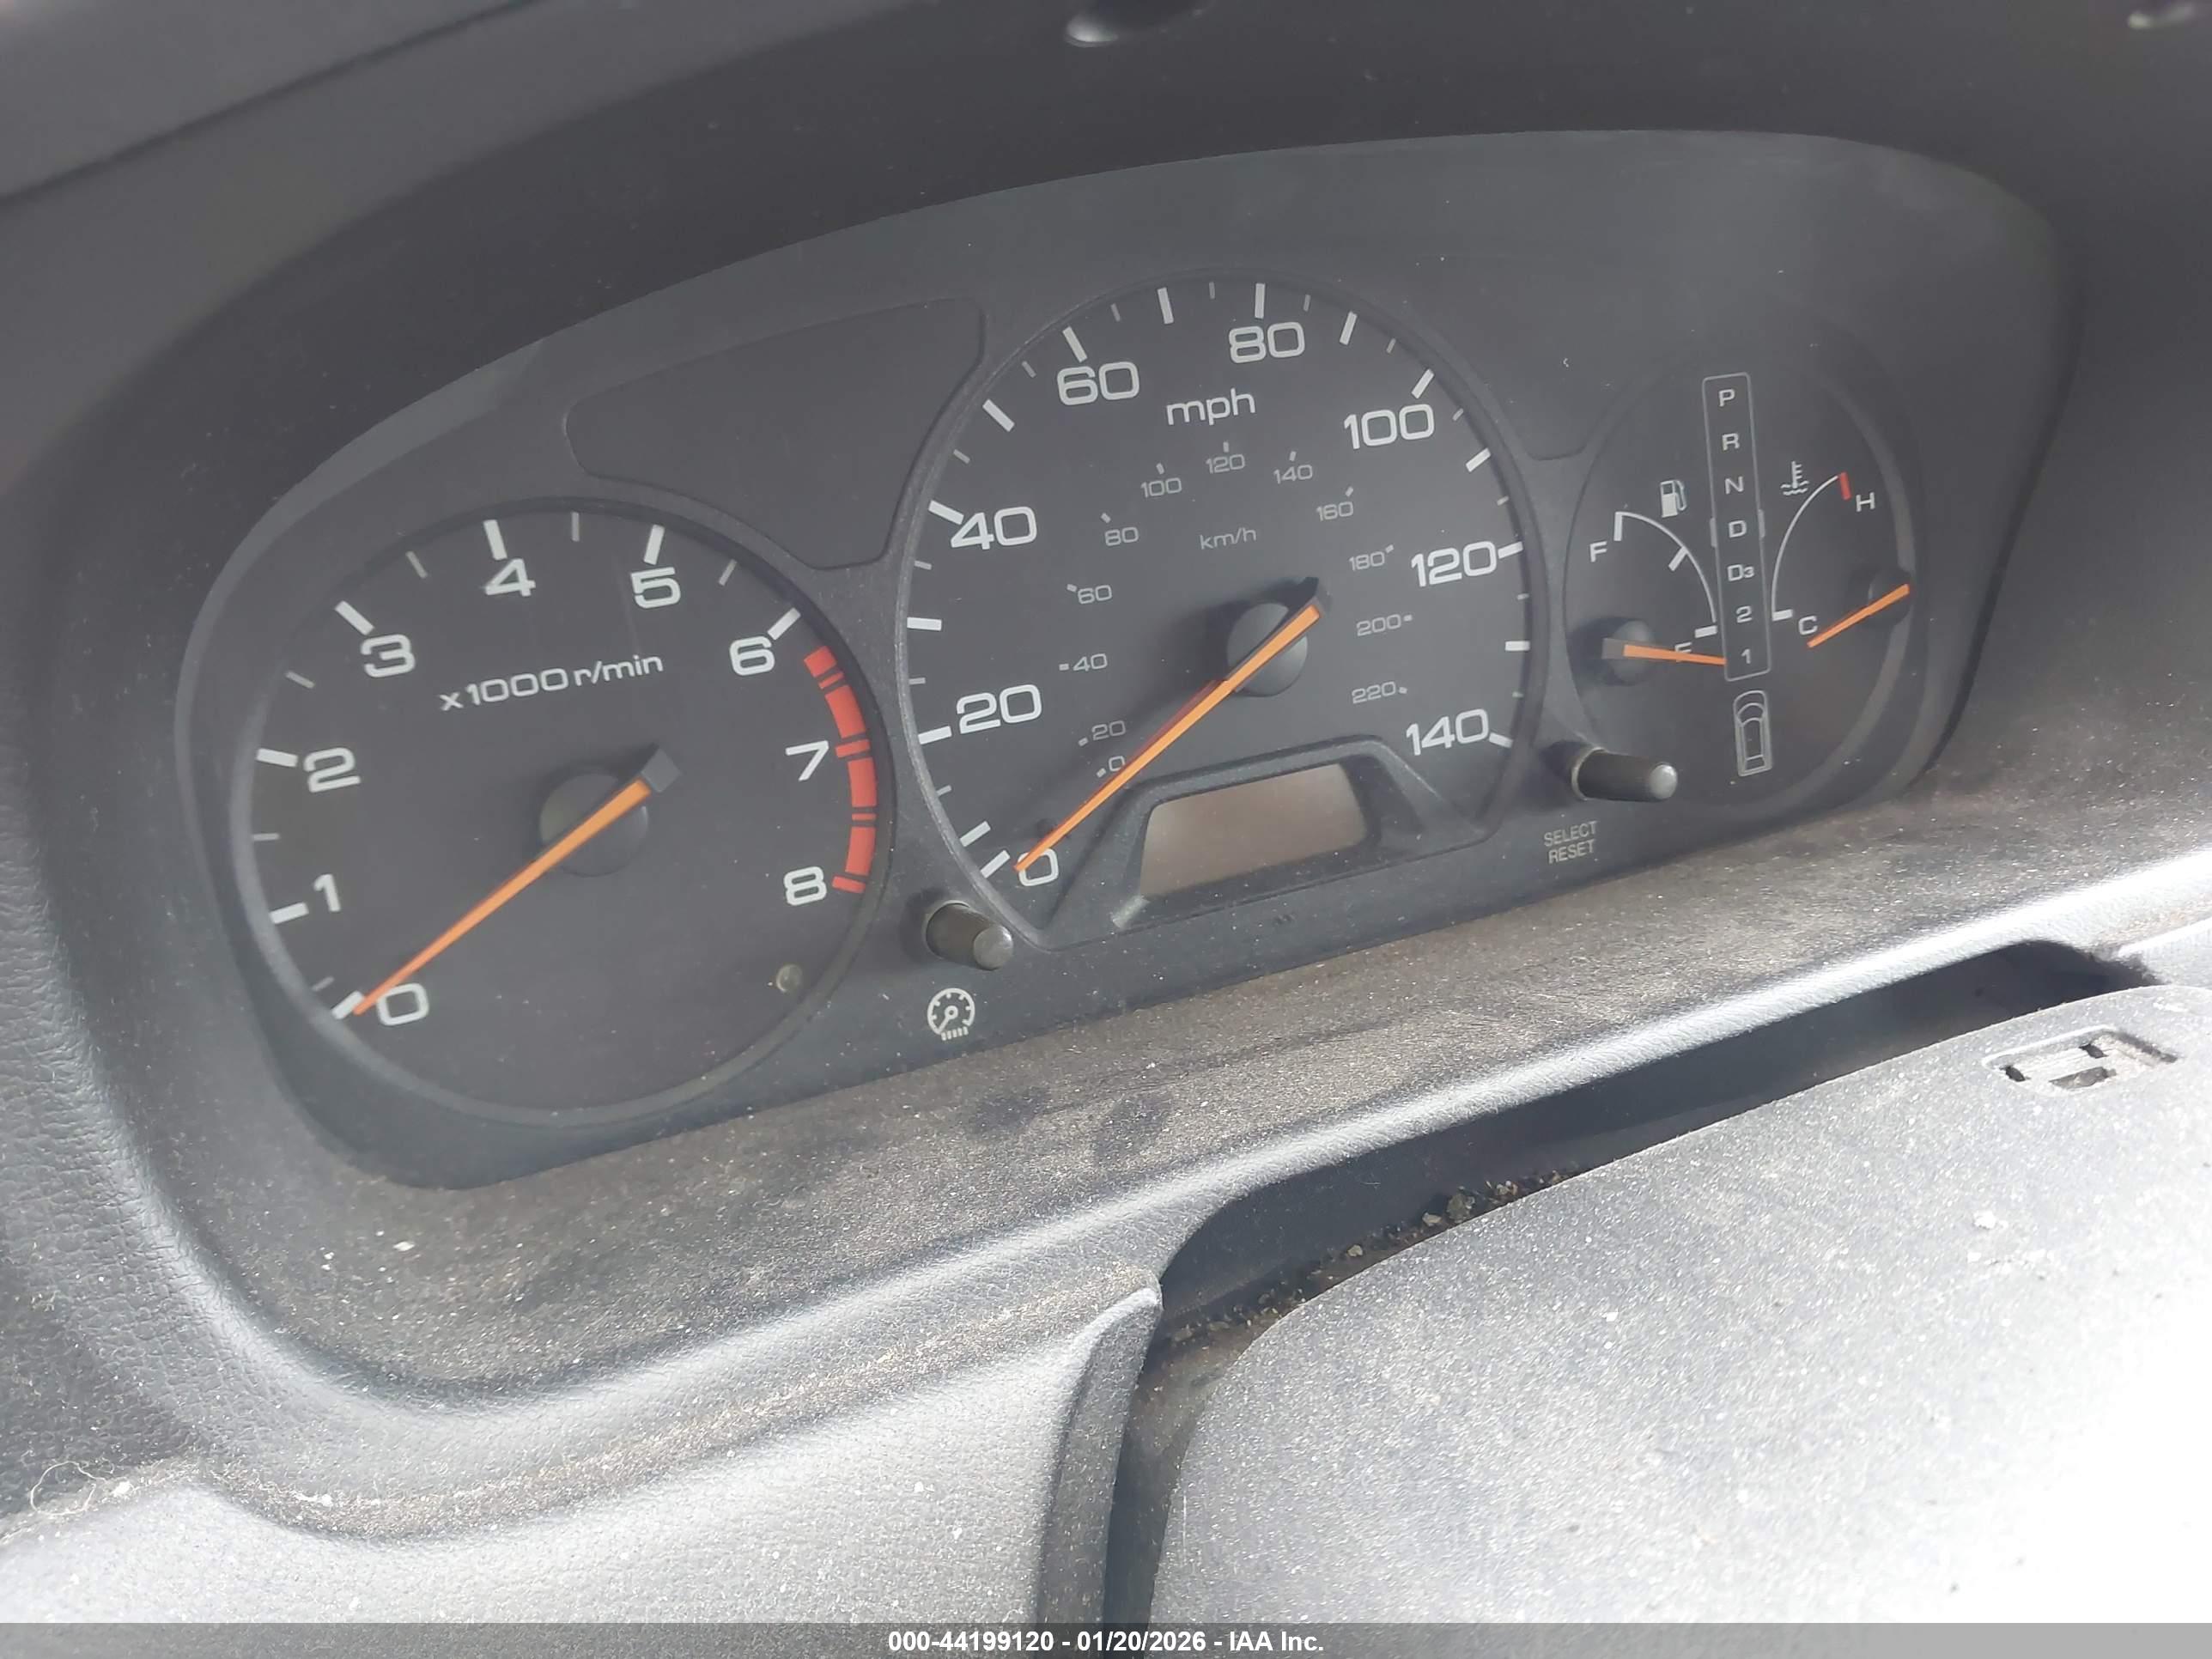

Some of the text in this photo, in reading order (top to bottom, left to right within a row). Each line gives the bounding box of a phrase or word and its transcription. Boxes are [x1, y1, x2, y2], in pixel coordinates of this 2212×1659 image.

[1228, 321, 1305, 364] 80
[1056, 361, 1140, 406] 60
[1166, 387, 1256, 426] mph
[1718, 388, 1735, 407] P
[1343, 404, 1435, 450] 100
[1722, 433, 1741, 451] R
[1206, 453, 1246, 474] 120
[1273, 464, 1314, 484] 140
[1140, 477, 1182, 498] 100
[1724, 476, 1744, 495] N
[1316, 501, 1354, 521] 160
[1856, 491, 1875, 513] H
[950, 506, 1037, 550] 40
[1104, 526, 1139, 547] 80
[1200, 526, 1257, 550] km/h
[1728, 520, 1747, 538] D
[1348, 550, 1386, 571] 180
[1411, 540, 1498, 587] 120
[1589, 541, 1607, 562] F
[484, 556, 537, 597] 4
[630, 567, 681, 609] 5
[1077, 584, 1113, 605] 60
[1356, 613, 1402, 636] 200
[1735, 605, 1753, 623] 2
[1798, 615, 1819, 635] C
[361, 634, 416, 678] 3
[729, 635, 776, 676] 6
[1073, 653, 1109, 672] 40
[1741, 648, 1752, 665] 1
[573, 654, 664, 686] r/min
[1351, 681, 1396, 704] 220
[956, 684, 1042, 734] 20
[1091, 720, 1127, 741] 20
[1406, 708, 1489, 757] 140
[303, 747, 361, 793] 2
[785, 739, 830, 781] 7
[1108, 755, 1126, 773] 0
[1543, 820, 1597, 848] SELECT
[1547, 837, 1595, 864] RESET
[1017, 848, 1060, 887] 0
[313, 873, 341, 912] 1
[783, 866, 828, 906] 8
[376, 982, 429, 1026] 0
